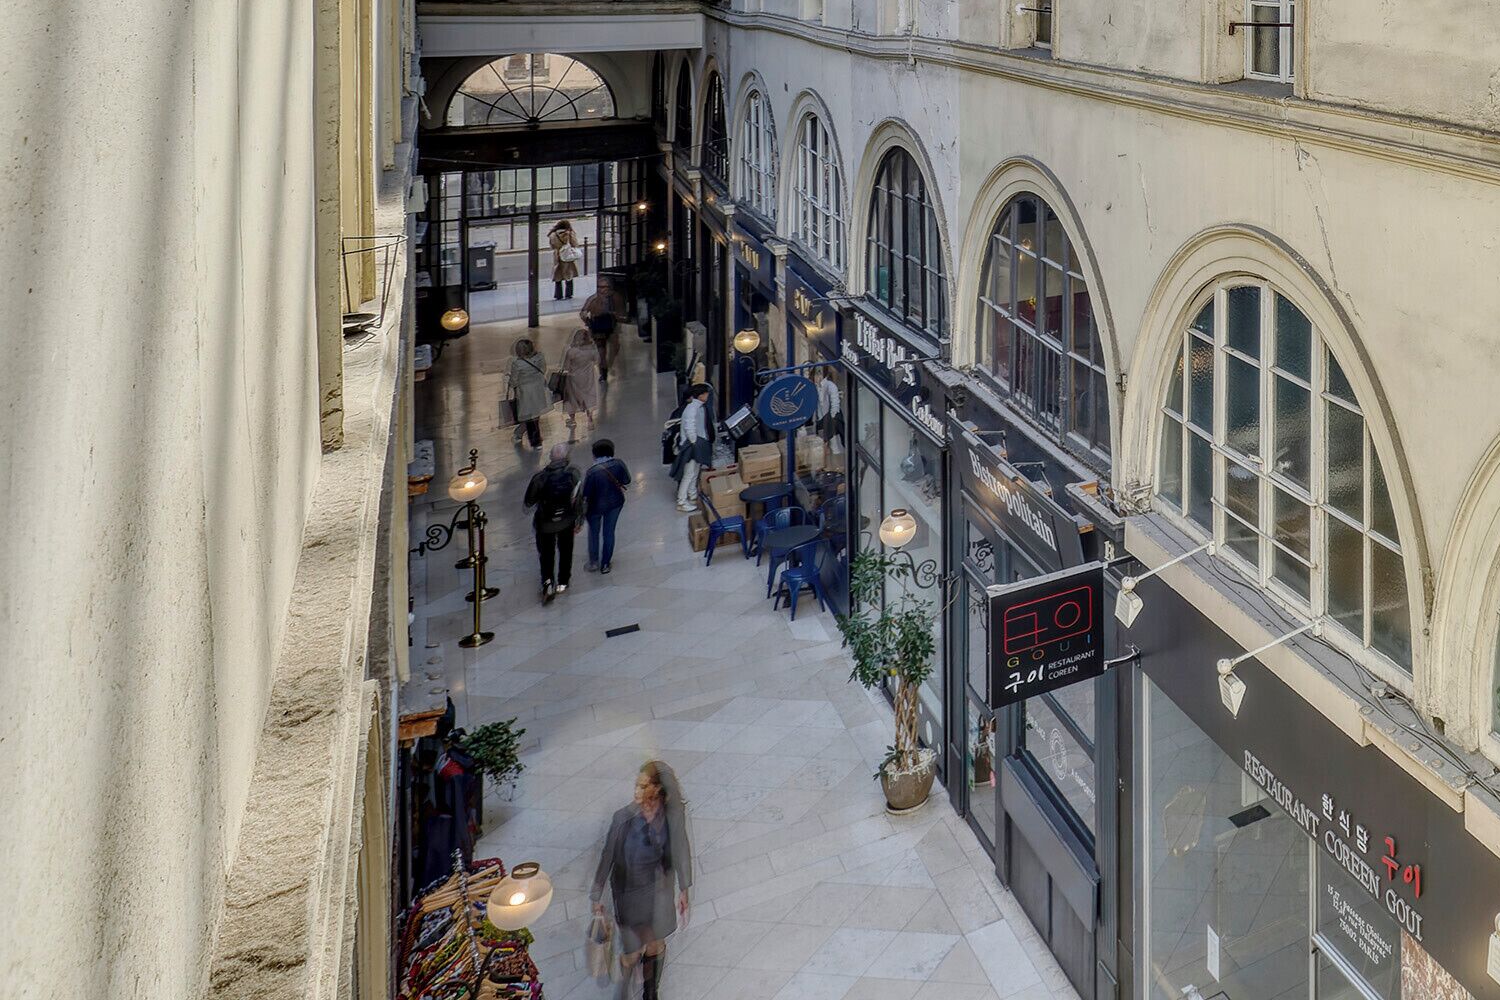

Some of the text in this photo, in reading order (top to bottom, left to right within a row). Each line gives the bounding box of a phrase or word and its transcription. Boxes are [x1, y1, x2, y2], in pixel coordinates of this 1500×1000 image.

[968, 448, 1057, 551] Bistropolitain
[1048, 649, 1096, 670] RESTAURANT
[1048, 664, 1079, 680] COREEN
[1004, 664, 1045, 694] 구이
[1244, 749, 1425, 942] RESTAURANT COREEN GOUI
[1342, 899, 1366, 928] passage
[1358, 938, 1380, 965] PARIS
